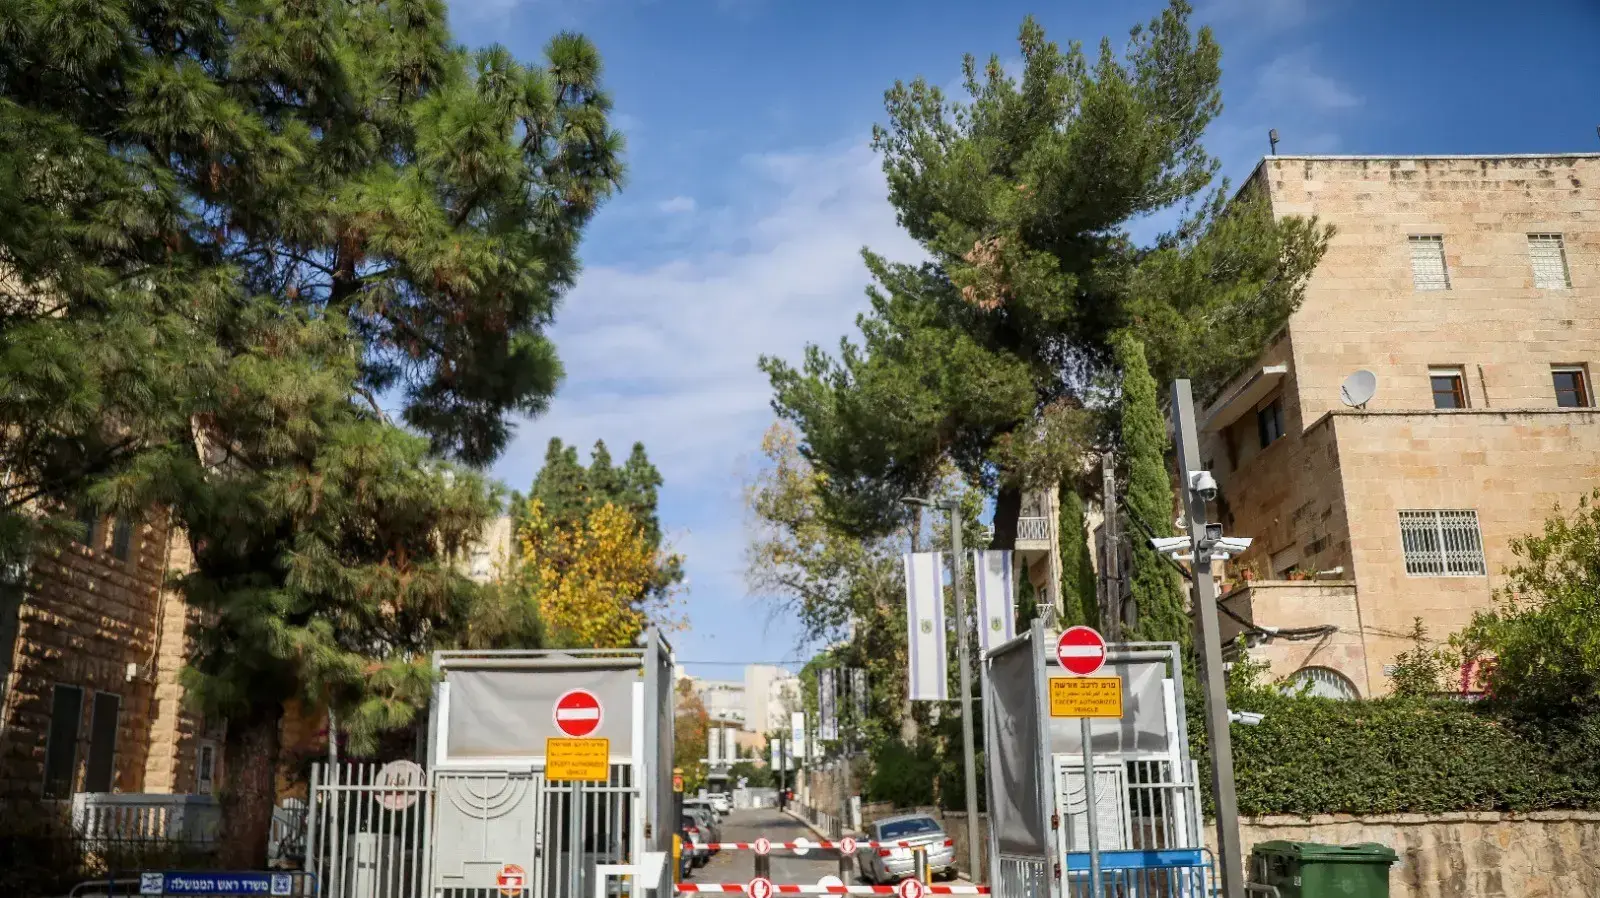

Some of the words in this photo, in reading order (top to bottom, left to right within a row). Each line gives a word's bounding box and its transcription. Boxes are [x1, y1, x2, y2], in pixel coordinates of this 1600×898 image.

[170, 877, 215, 890] הממשלה
[217, 879, 239, 890] ראש
[241, 879, 269, 891] משרד
